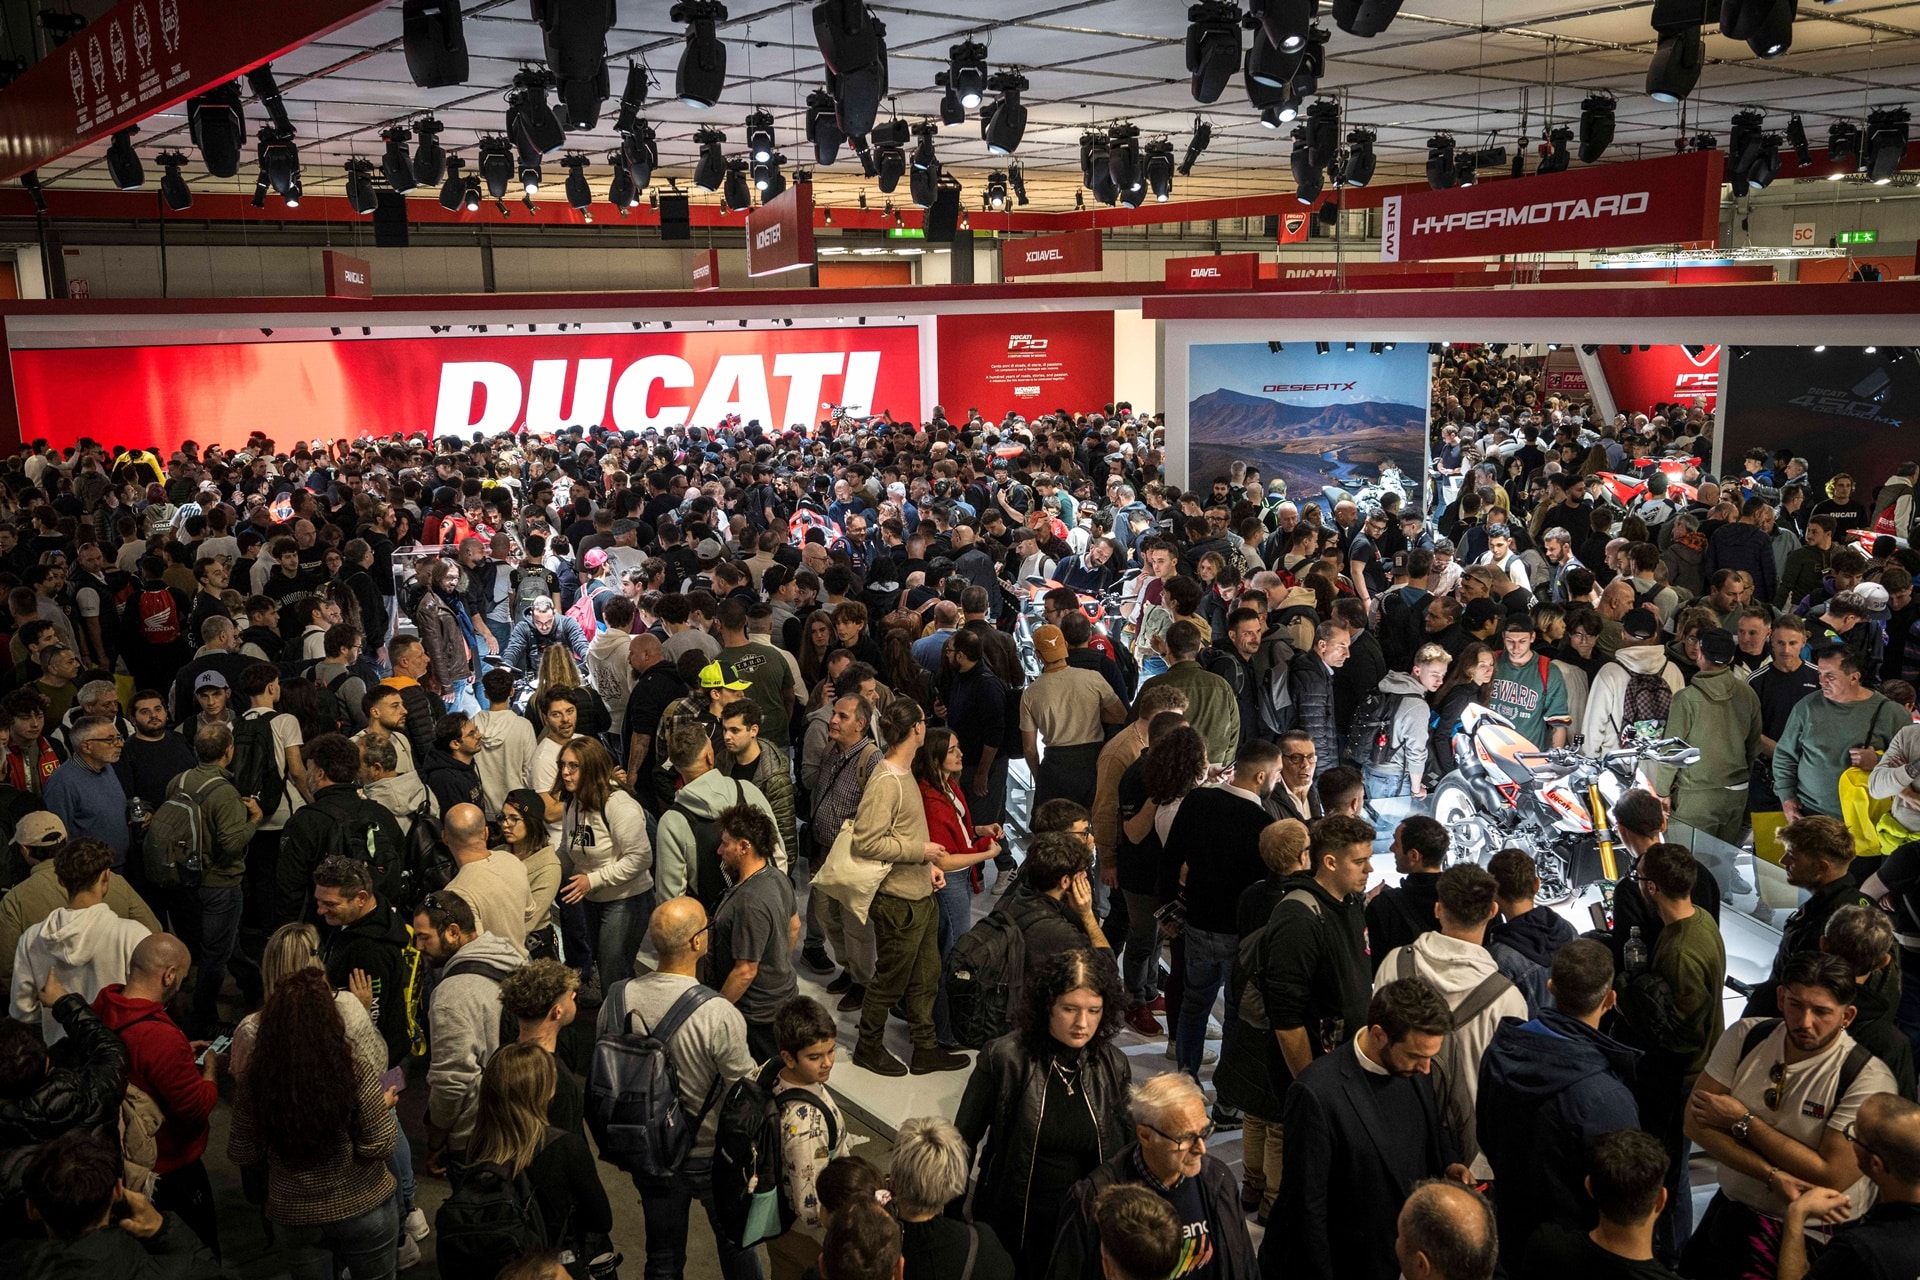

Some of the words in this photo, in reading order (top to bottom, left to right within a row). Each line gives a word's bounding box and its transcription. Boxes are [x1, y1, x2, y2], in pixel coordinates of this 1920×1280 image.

[1411, 191, 1650, 236] HYPERMOTARD
[1387, 202, 1397, 255] NEW
[1795, 228, 1813, 240] 5C
[1025, 249, 1063, 262] XDIAVEL
[1191, 268, 1221, 277] DIAVEL
[1263, 381, 1357, 392] DESERTX
[1808, 387, 1848, 398] DUCATI
[433, 351, 881, 439] DUCATI
[1788, 395, 1881, 416] 450
[1550, 793, 1572, 811] DUCATI
